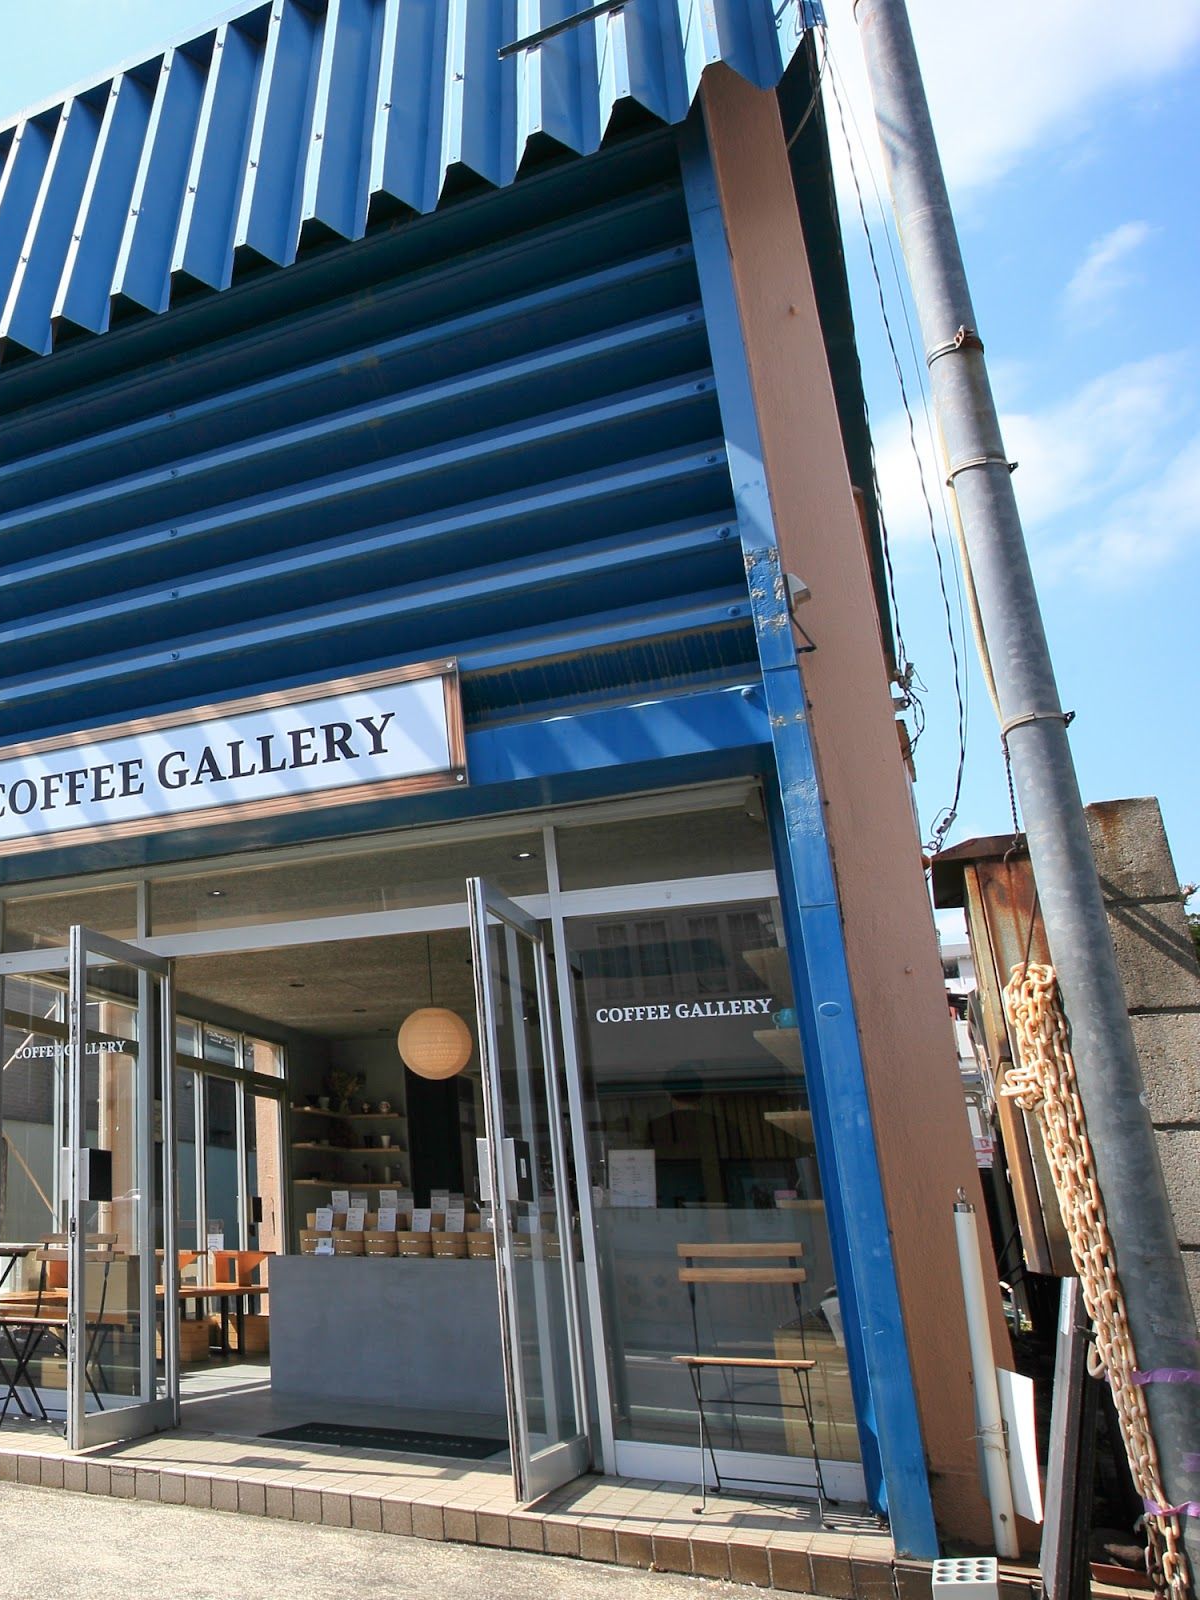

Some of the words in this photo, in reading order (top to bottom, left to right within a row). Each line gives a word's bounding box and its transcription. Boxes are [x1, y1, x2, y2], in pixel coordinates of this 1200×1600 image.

[157, 712, 396, 790] GALLERY
[594, 1004, 672, 1024] COFFEE
[674, 998, 773, 1020] GALLERY
[15, 1045, 63, 1059] COFFEE
[64, 1040, 126, 1057] GLLERY
